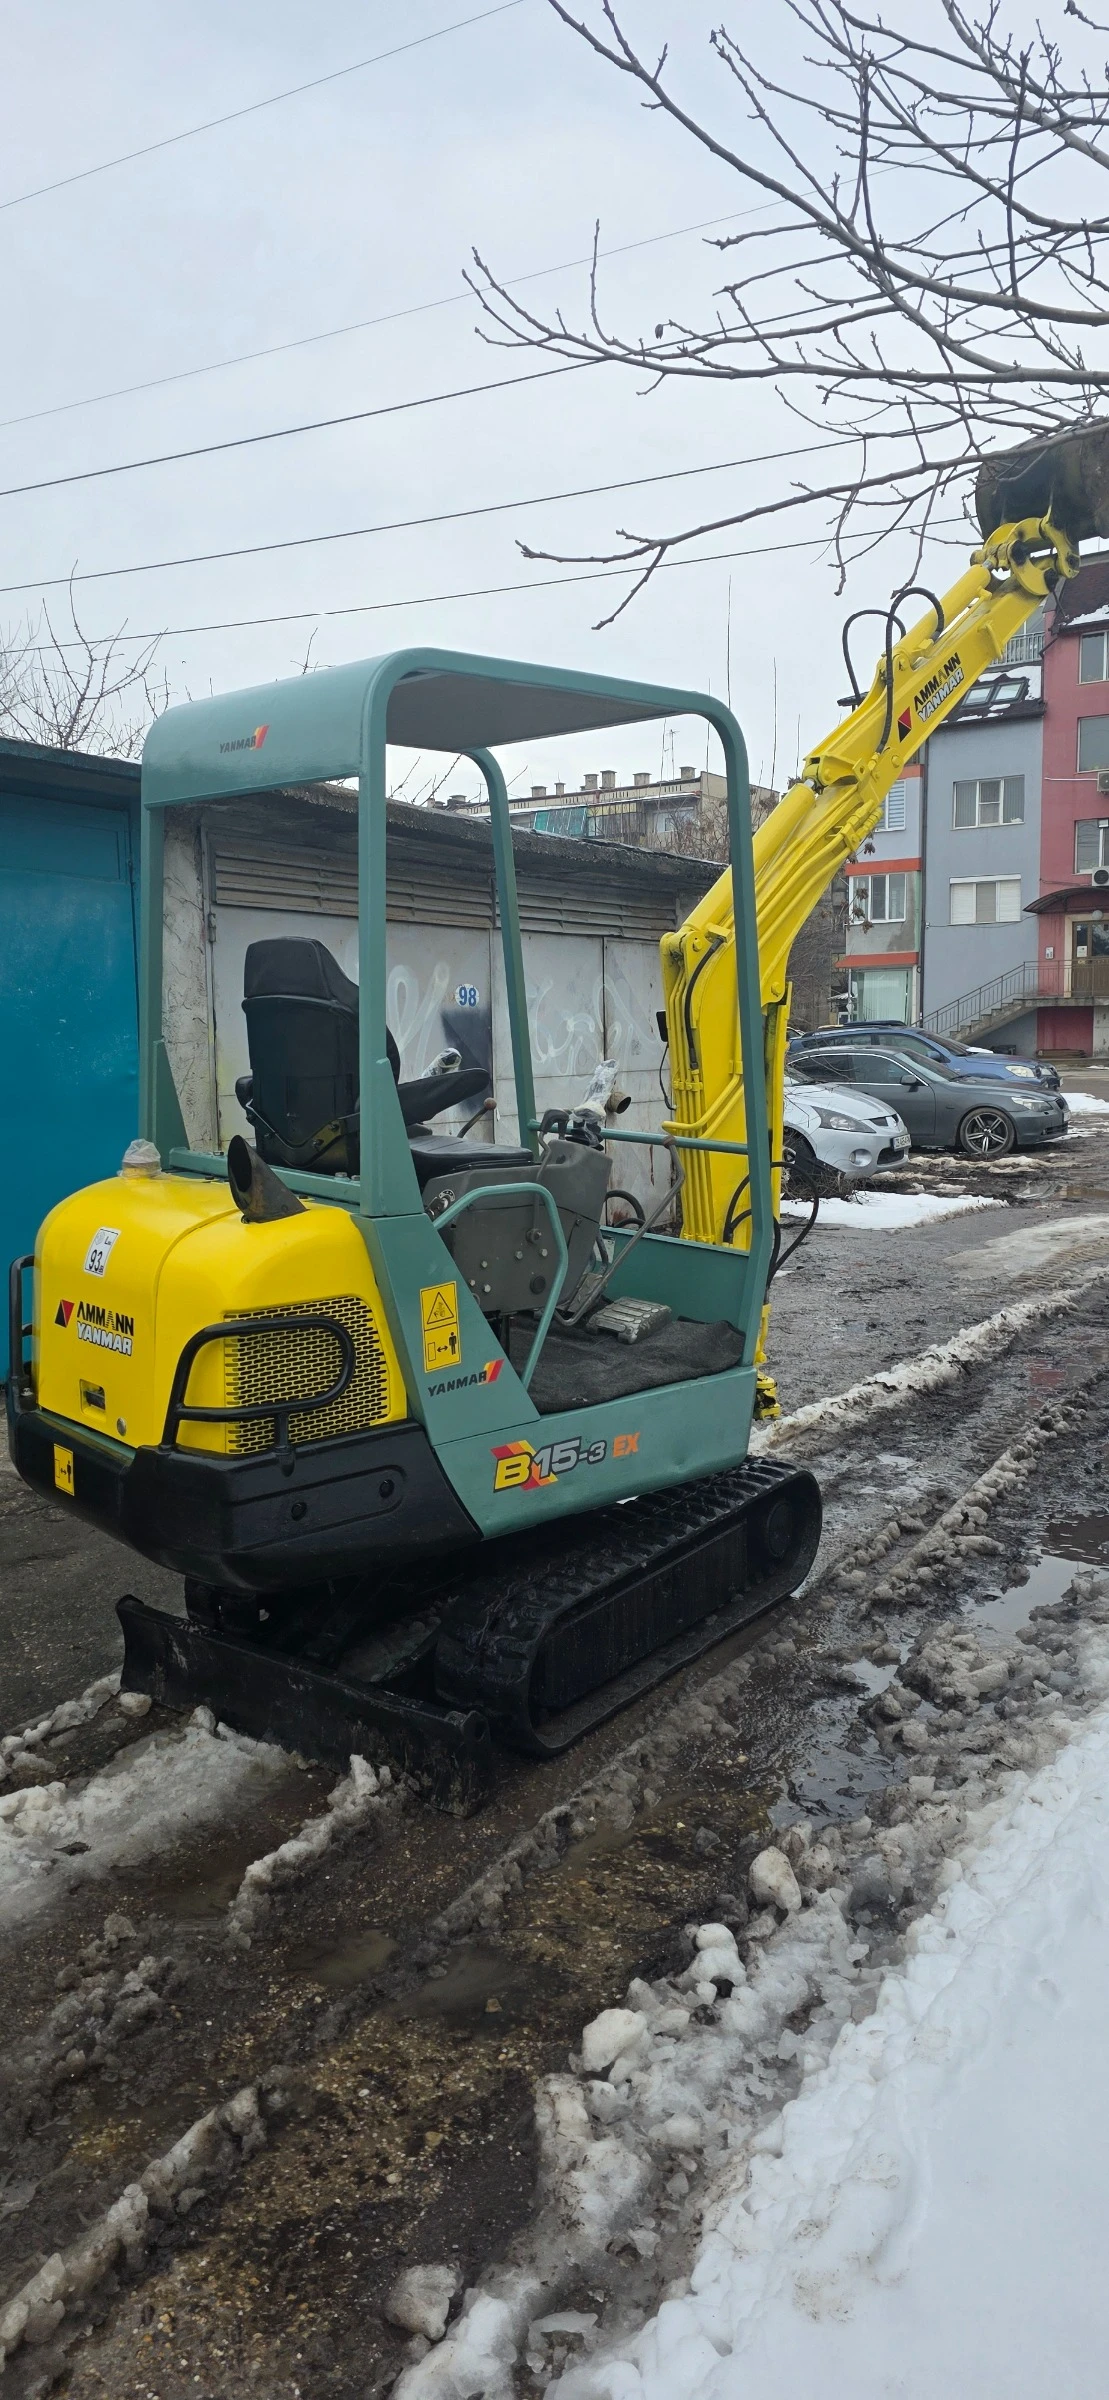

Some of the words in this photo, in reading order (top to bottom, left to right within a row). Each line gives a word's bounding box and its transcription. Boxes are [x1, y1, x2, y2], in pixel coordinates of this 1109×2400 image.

[914, 652, 961, 712] AMMANN
[918, 666, 964, 722] YANMAR
[219, 735, 257, 754] YANMAR
[459, 986, 477, 1007] 98
[88, 1249, 103, 1271] 93
[77, 1300, 134, 1336] AMMANN
[77, 1320, 133, 1356] YANMAR
[428, 1370, 487, 1397] YANMAR
[613, 1432, 641, 1457] EX
